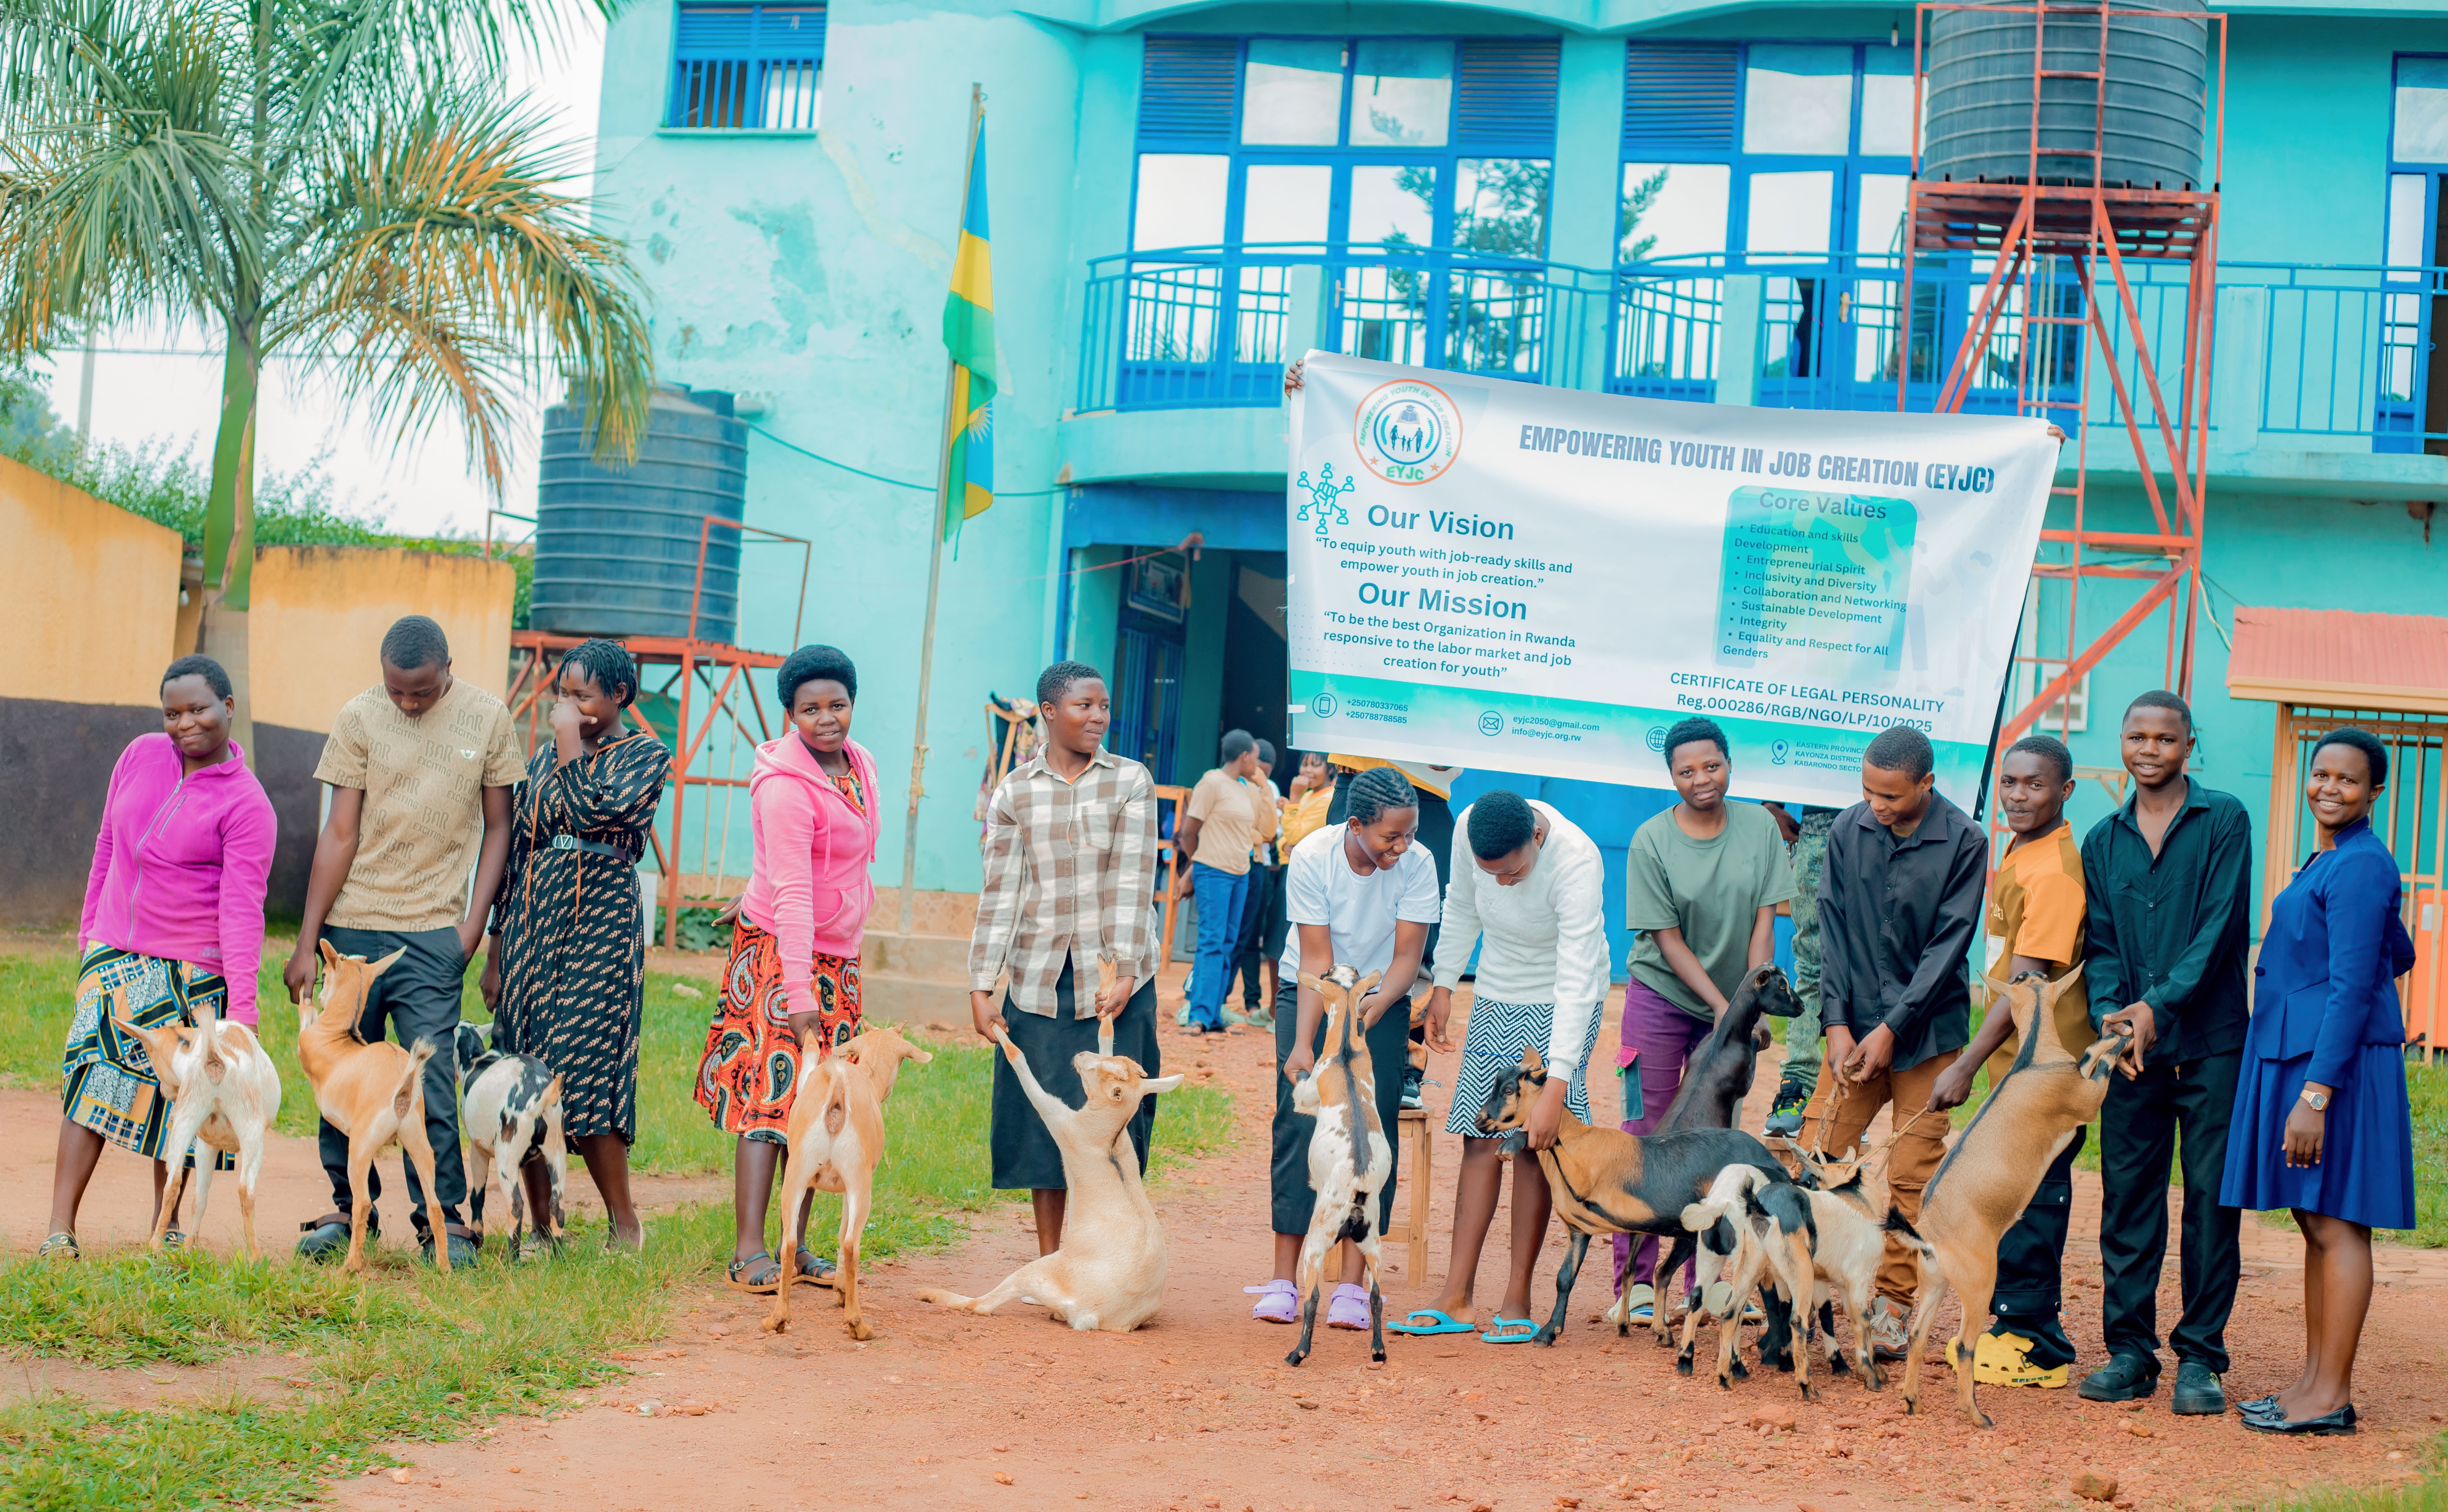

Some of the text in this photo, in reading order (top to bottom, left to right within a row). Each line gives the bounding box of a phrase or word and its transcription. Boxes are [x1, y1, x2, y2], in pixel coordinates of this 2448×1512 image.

[1359, 394, 1388, 446] EMPOWERING
[1390, 386, 1420, 396] YOUTH
[1430, 399, 1444, 412] JOB
[1441, 415, 1452, 457] CREATION
[1520, 425, 1994, 493] EMPOWERING YOUTH IN JOB CREATION (EYJC)
[1386, 465, 1424, 480] EYJC
[1760, 493, 1886, 519] Core Values
[1368, 505, 1513, 540] Our Vision
[1750, 524, 1858, 543] Education and skills
[1341, 541, 1375, 555] equip
[1378, 546, 1415, 556] youth
[1420, 548, 1446, 559] with
[1448, 550, 1511, 569] job-ready
[1514, 558, 1545, 570] skills
[1549, 563, 1572, 573] and
[1735, 539, 1808, 553] Development
[1341, 561, 1399, 573] empower
[1401, 567, 1438, 577] youth
[1443, 568, 1454, 579] in
[1456, 570, 1477, 582] job
[1747, 555, 1865, 575] Entrepreneurial Spirit
[1746, 571, 1877, 593] Inclusivity and Diversity
[1359, 583, 1526, 620] Our Mission
[1744, 586, 1906, 612] Collaboration and Networking
[1742, 601, 1882, 623] Sustainable Development
[1349, 613, 1364, 625] be
[1368, 616, 1388, 627] the
[1393, 618, 1420, 631] best
[1424, 622, 1505, 640] Organization
[1510, 630, 1521, 641] in
[1525, 632, 1575, 647] Rwanda
[1740, 616, 1787, 631] Integrity
[1324, 632, 1571, 667] responsive to the labor market and job
[1724, 645, 1768, 658] Genders
[1739, 631, 1888, 655] Equality and Respect for All
[1384, 658, 1436, 670] creation
[1441, 661, 1459, 672] for
[1671, 673, 1944, 712] CERTIFICATE OF LEGAL PERSONALITY
[1347, 699, 1408, 711] +250780337065
[457, 707, 483, 732] BAR
[1346, 711, 1407, 724] +250788788585
[1513, 716, 1599, 731] eyjc2050@gmail.com
[385, 724, 422, 744] EXCITING
[449, 724, 482, 746] EXCITING
[1512, 727, 1581, 741] info@eyjc.org.rw
[425, 738, 454, 762] BAR
[1795, 751, 1862, 763] KAYONZA DISTRICT
[1797, 742, 1866, 754] EASTERN PROVINCE
[417, 756, 452, 777] EXCITING
[1795, 760, 1837, 769] KABARONDO
[392, 772, 421, 796] BAR
[383, 787, 419, 809] EXCITING
[422, 805, 449, 830] BAR
[412, 822, 446, 844] EXCITING
[386, 837, 414, 860] BAR
[377, 851, 411, 874] EXCITING
[352, 861, 380, 887] BAR
[413, 870, 439, 889] BAR
